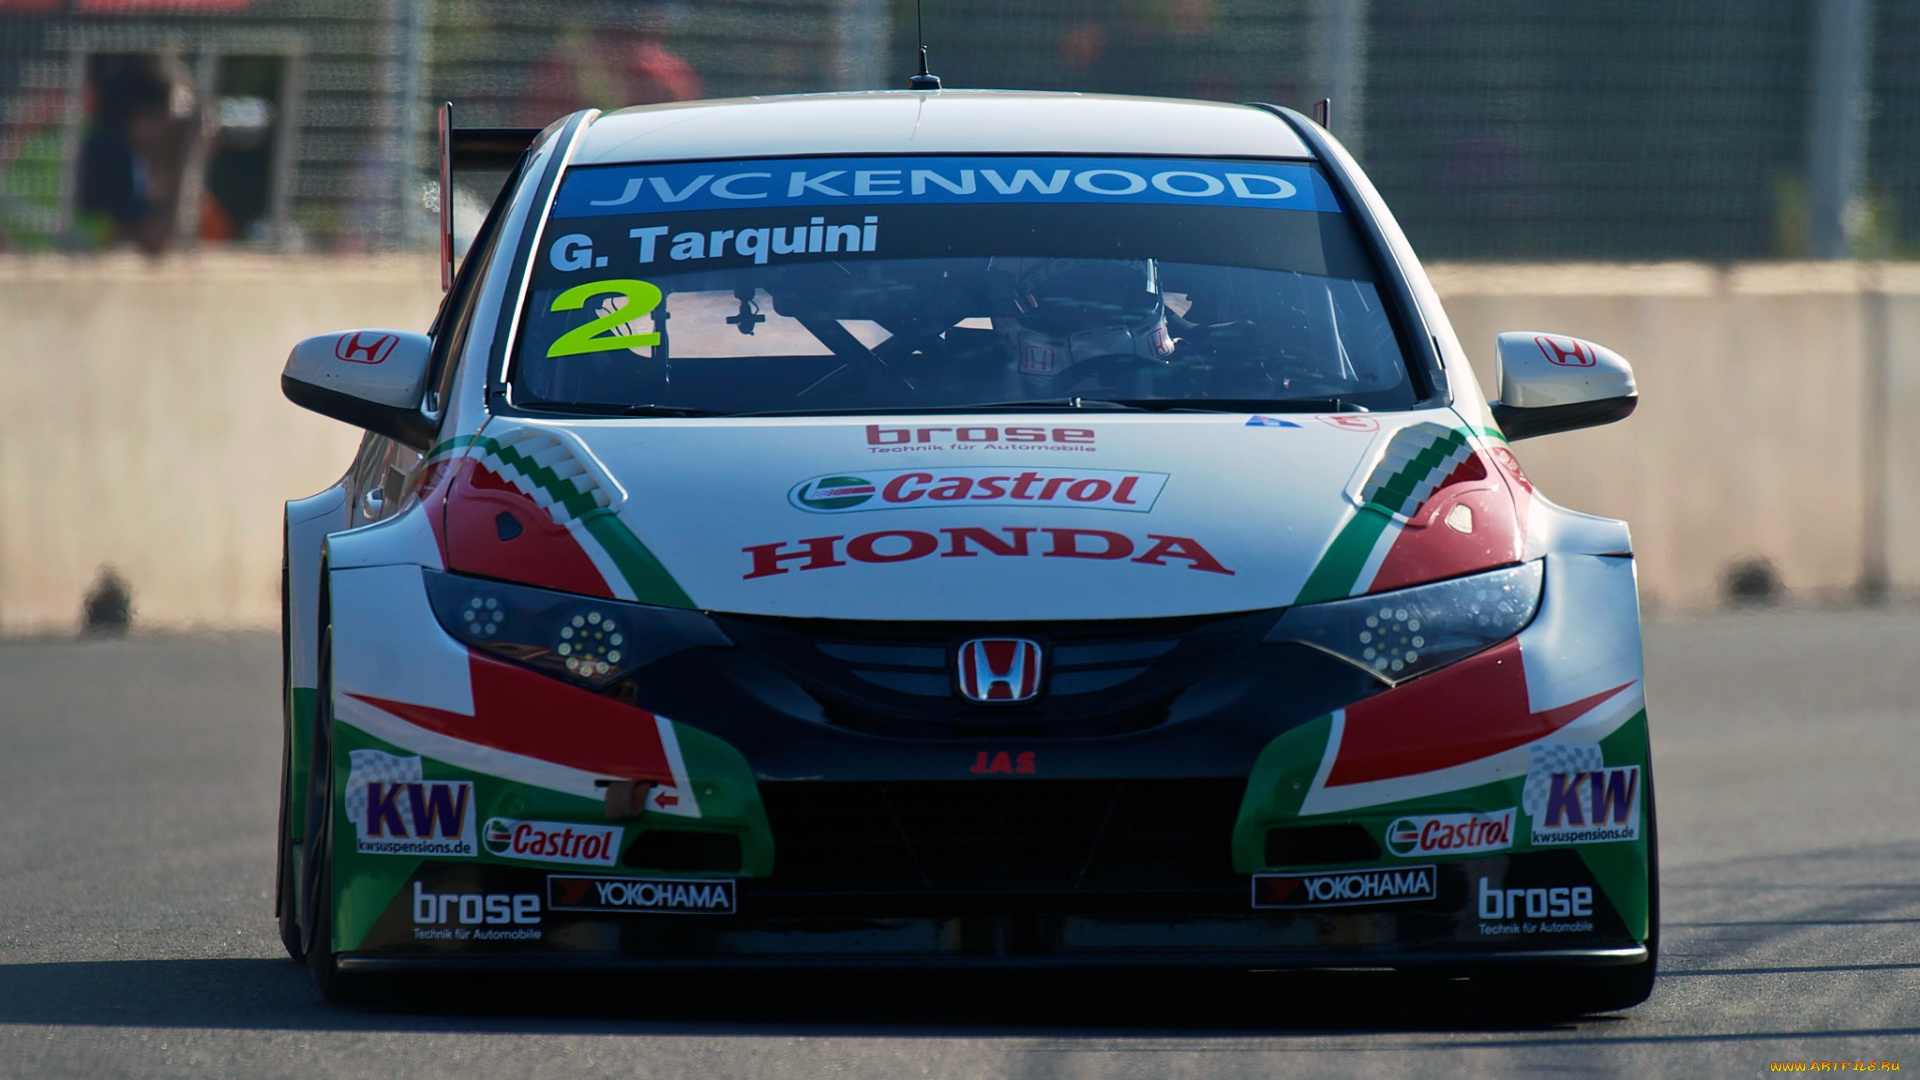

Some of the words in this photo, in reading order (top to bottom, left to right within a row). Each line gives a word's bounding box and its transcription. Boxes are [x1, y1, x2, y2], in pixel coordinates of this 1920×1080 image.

[549, 233, 609, 272] G.
[629, 215, 879, 265] Tarquini
[546, 279, 662, 358] 2
[865, 424, 1095, 445] brose
[868, 444, 944, 453] Technik
[983, 443, 1096, 452] Automobile
[881, 472, 1139, 505] Castrol
[742, 526, 1235, 580] HONDA
[367, 782, 470, 839] KW
[1544, 768, 1637, 829] KW
[513, 824, 613, 860] Castrol
[1420, 814, 1509, 851] Castrol
[1533, 827, 1634, 843] kwsuspensions.de
[413, 881, 541, 924] brose
[595, 881, 730, 908] YOKOHAMA
[1303, 871, 1430, 901] YOKOHAMA
[1478, 877, 1593, 919] brose
[414, 929, 452, 939] Technik
[455, 929, 470, 940] für
[473, 929, 542, 940] Automobile
[1479, 923, 1520, 934] Technik
[1522, 922, 1537, 933] für
[1540, 921, 1594, 933] Automobile
